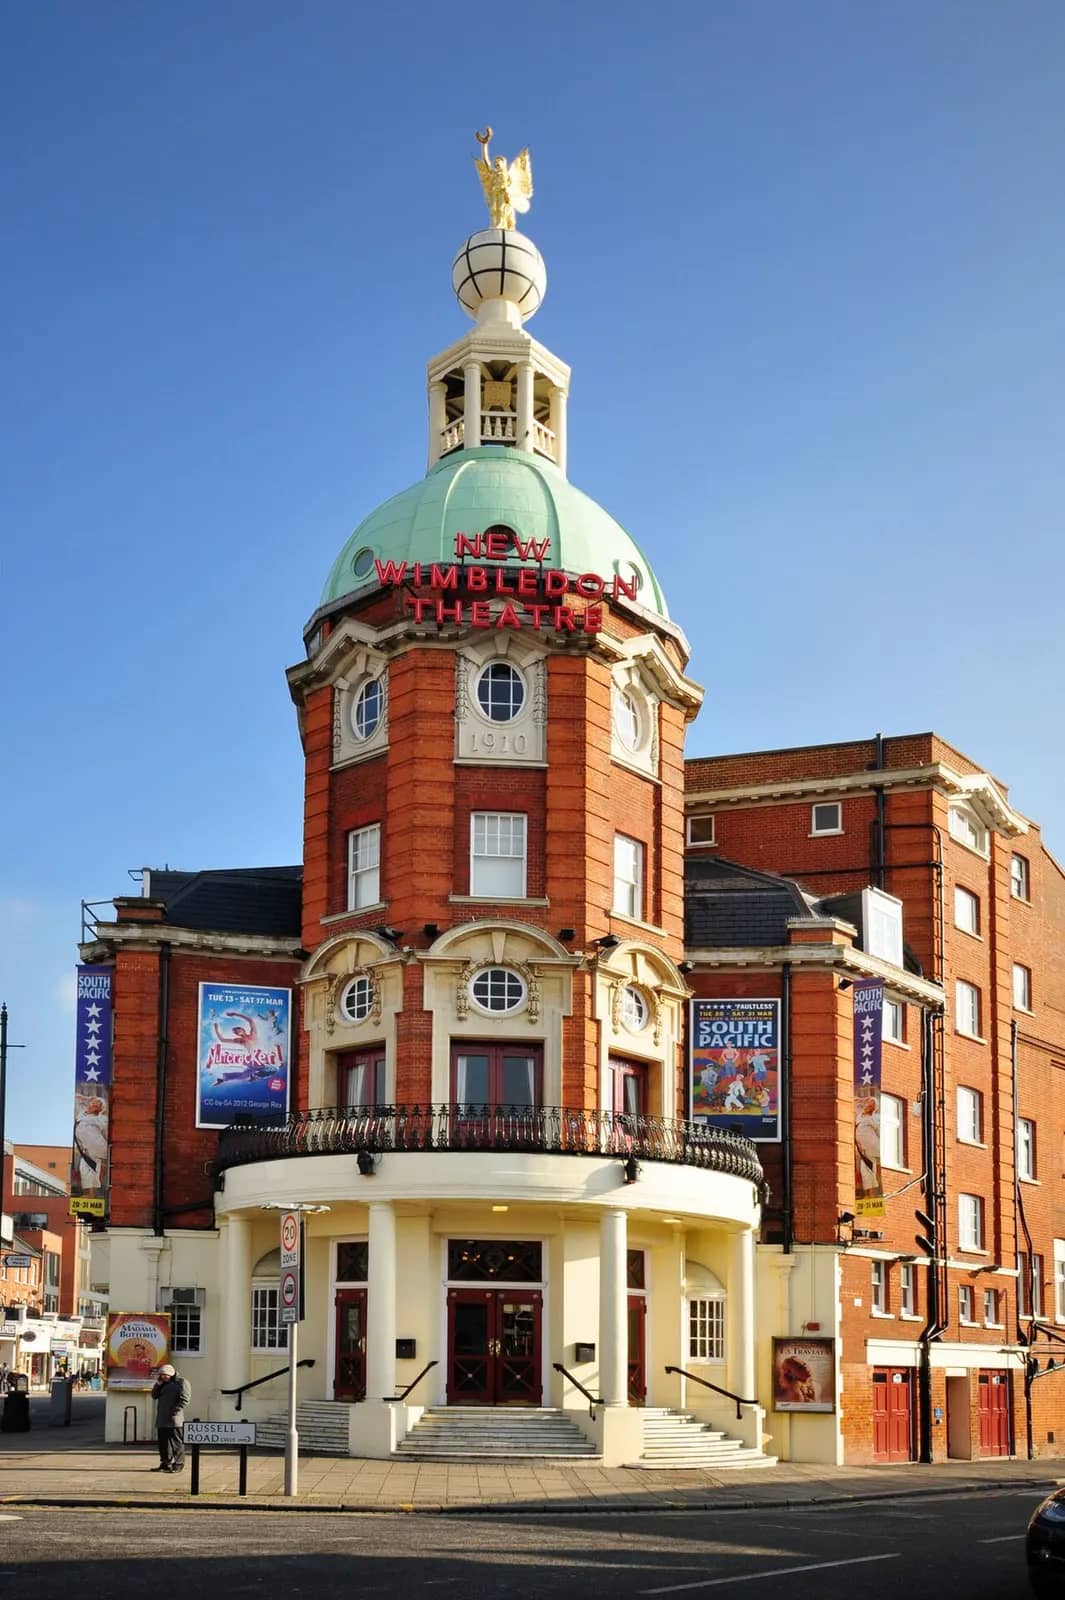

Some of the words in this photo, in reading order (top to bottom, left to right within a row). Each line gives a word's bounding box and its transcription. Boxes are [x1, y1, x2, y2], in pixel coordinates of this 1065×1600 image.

[456, 532, 551, 562] NEW
[375, 559, 639, 601] WIMBLEDON
[406, 598, 603, 633] THEATRE
[472, 733, 530, 755] 1910
[79, 976, 111, 988] SOUTH
[79, 987, 111, 999] PACIFIC
[854, 988, 882, 1002] SOUTH
[240, 996, 254, 1004] SAT
[265, 998, 283, 1006] MAR
[854, 999, 882, 1014] PACIFIC
[699, 1021, 773, 1034] SOUTH
[699, 1034, 773, 1047] PACIFIC
[285, 1226, 295, 1240] 20
[283, 1253, 296, 1264] ZONE
[188, 1424, 236, 1433] RUSSELL
[187, 1434, 219, 1442] ROAD
